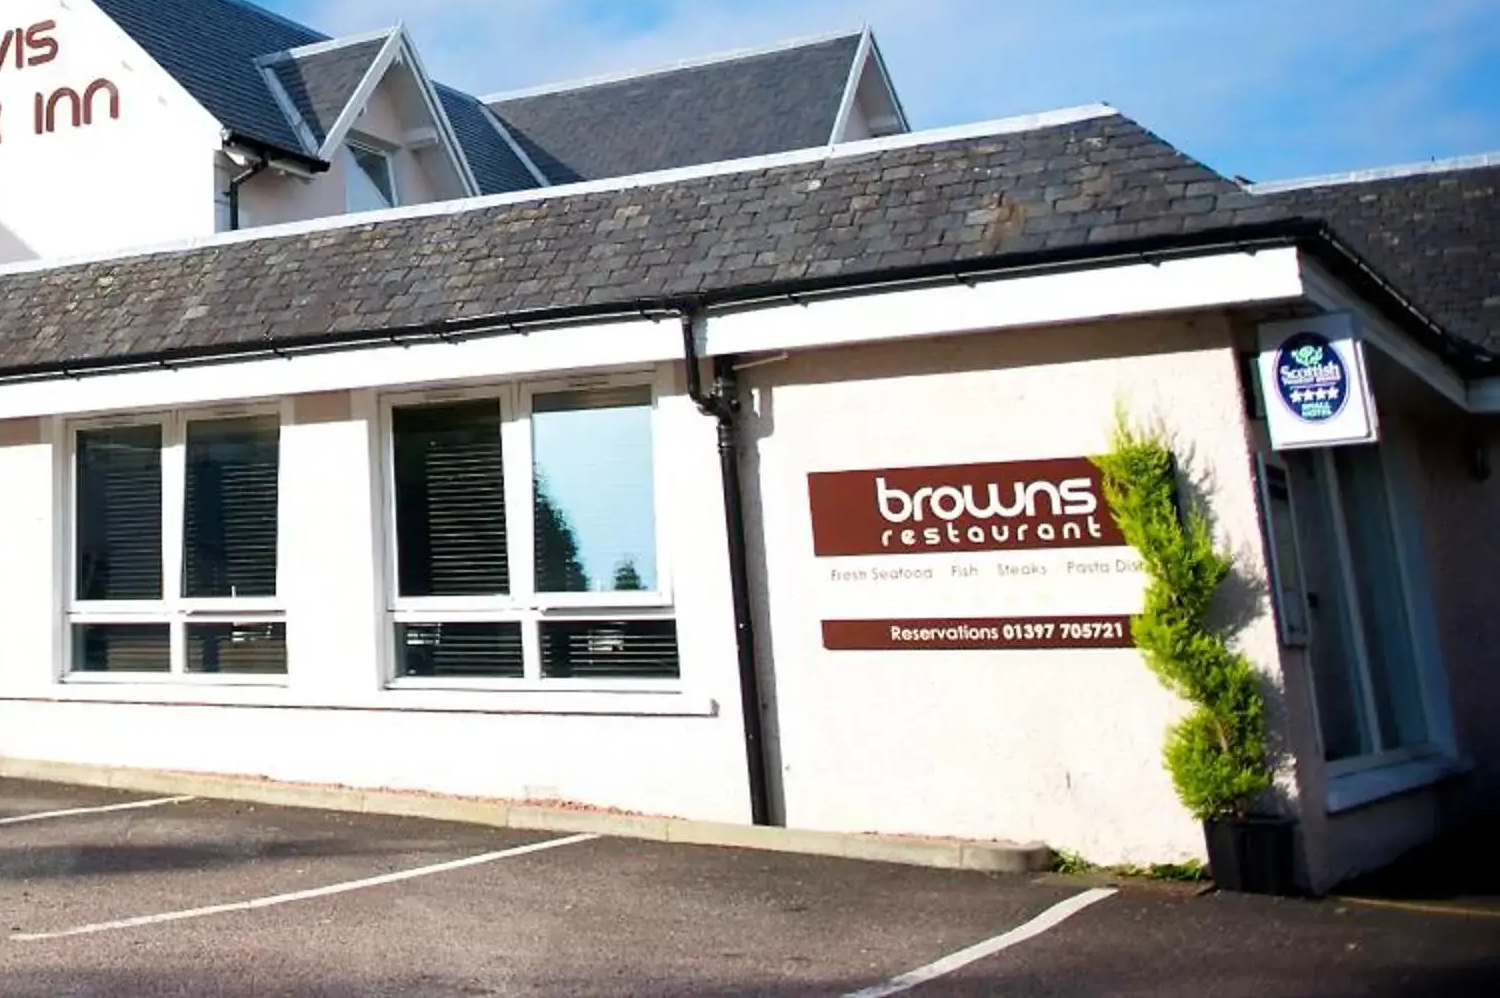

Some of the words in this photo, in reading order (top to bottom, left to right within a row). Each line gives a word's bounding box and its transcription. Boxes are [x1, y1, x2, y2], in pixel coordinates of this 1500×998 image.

[35, 78, 119, 134] inn
[1280, 361, 1341, 381] Scottish
[875, 476, 1097, 523] browns
[880, 517, 1102, 547] restaurant
[830, 568, 867, 582] Fresh
[871, 566, 934, 581] Seafood
[951, 563, 979, 578] Fish
[997, 561, 1048, 576] Steaks
[1067, 559, 1110, 575] Pasta
[890, 624, 999, 642] Reservations
[1003, 623, 1056, 640] 01397
[1059, 621, 1124, 640] 705721
